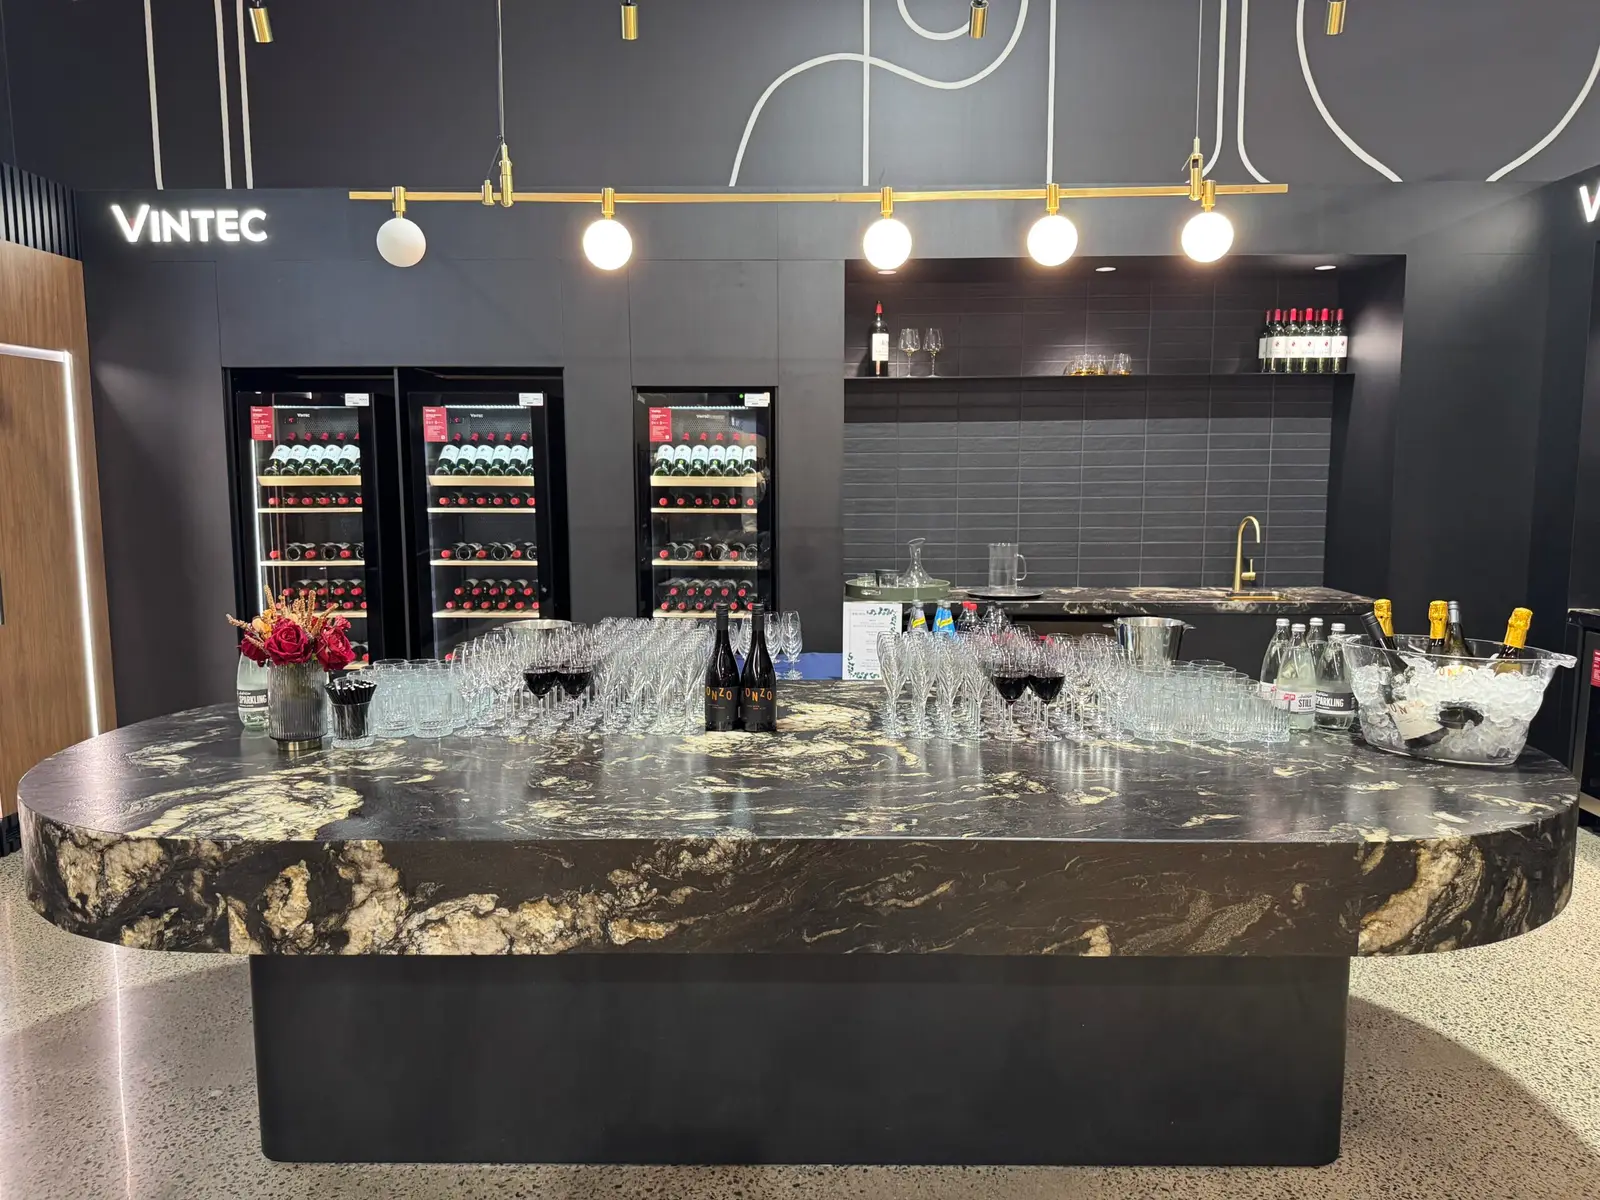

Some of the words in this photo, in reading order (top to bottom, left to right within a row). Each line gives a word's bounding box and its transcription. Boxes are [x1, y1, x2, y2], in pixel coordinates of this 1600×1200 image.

[110, 204, 268, 243] VINTEC
[705, 686, 733, 701] ONZO
[744, 687, 773, 702] ONZO
[1298, 698, 1312, 708] STILL
